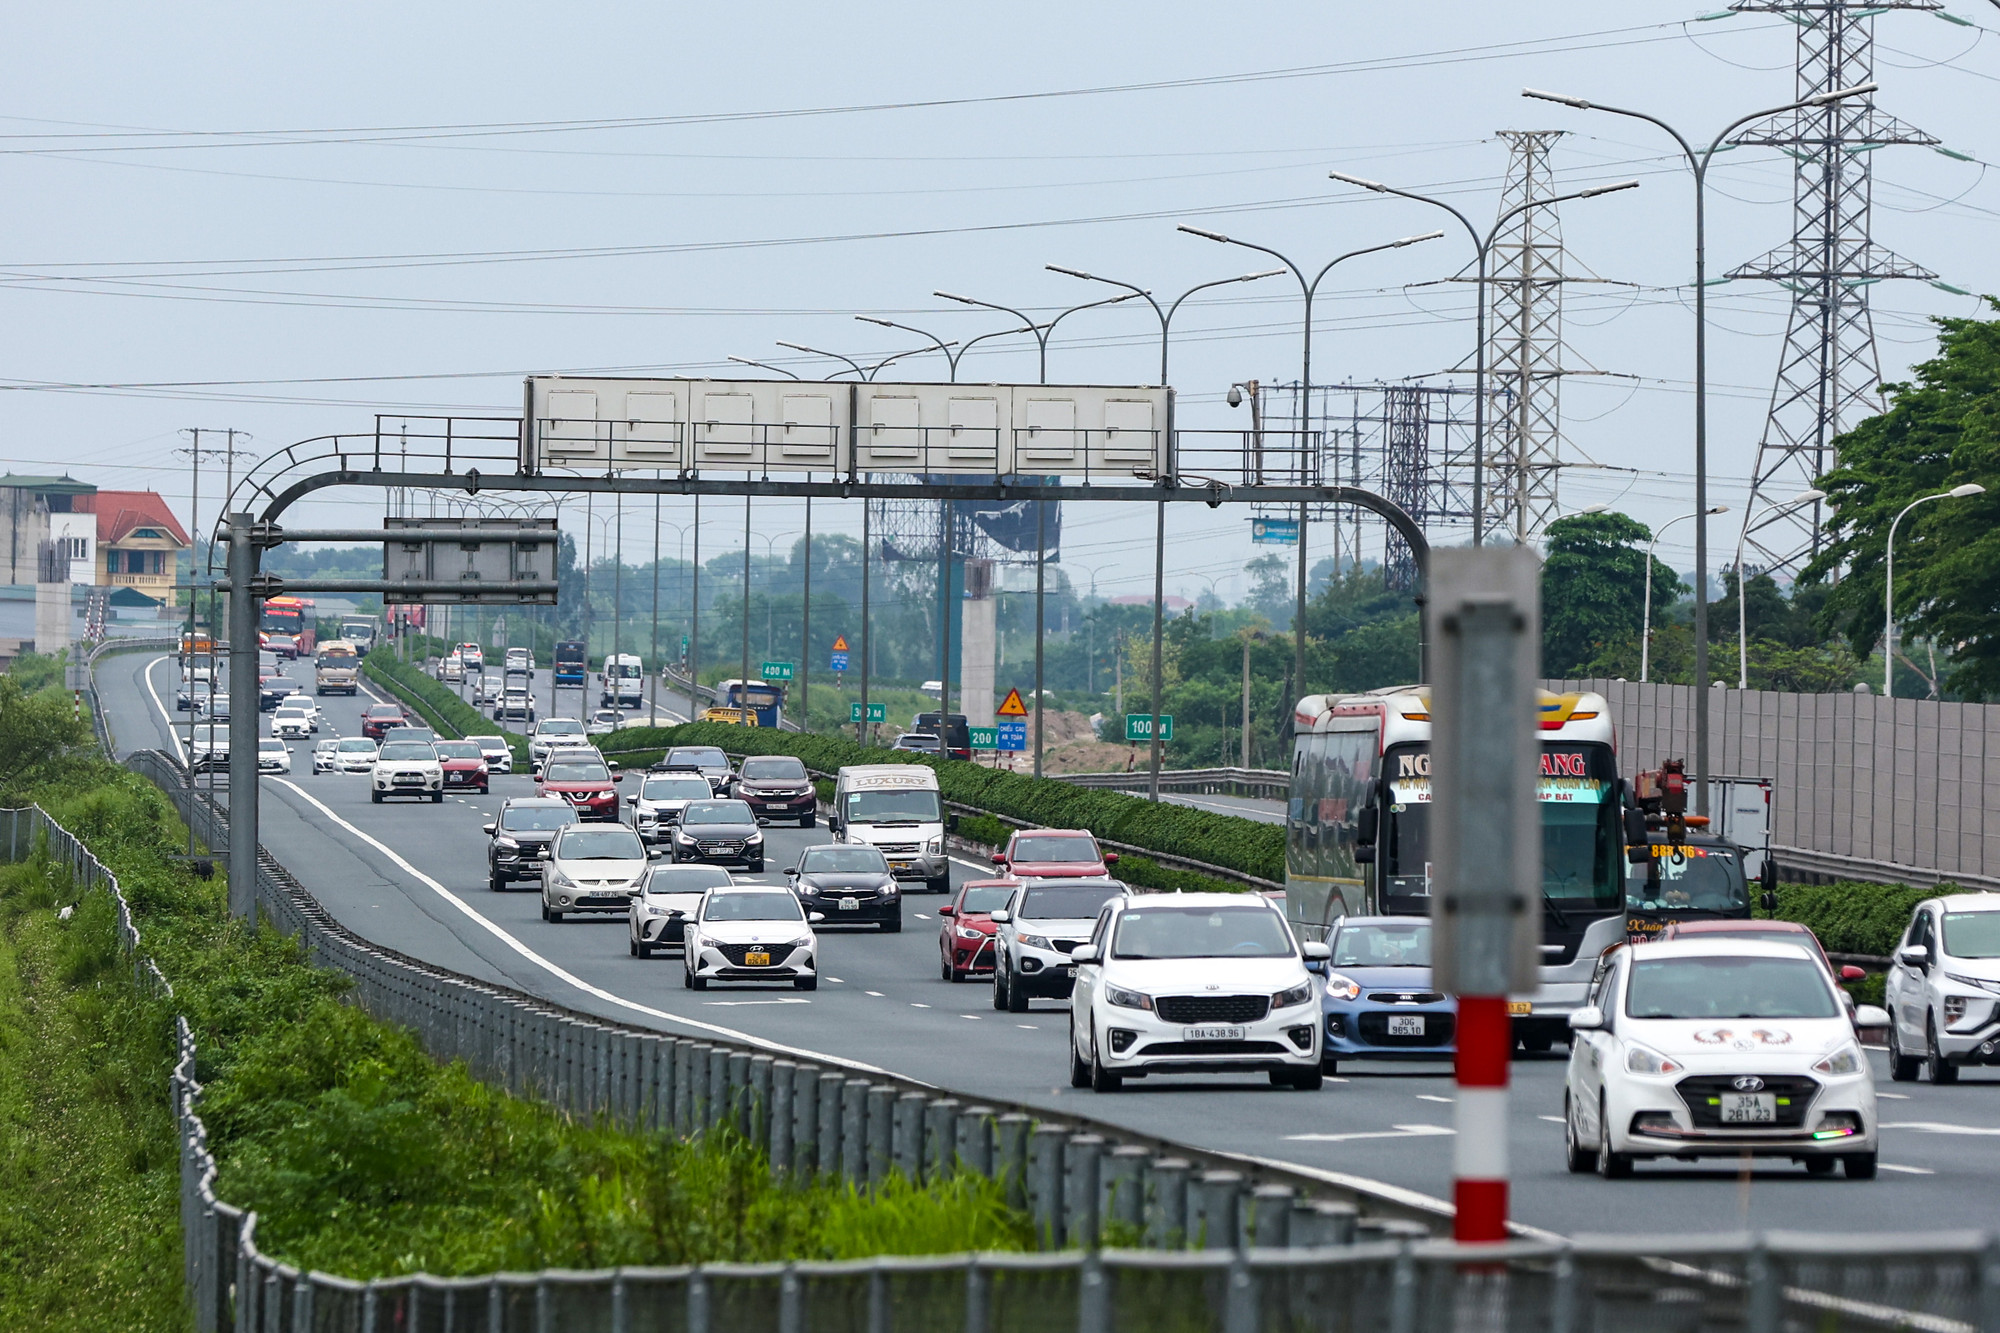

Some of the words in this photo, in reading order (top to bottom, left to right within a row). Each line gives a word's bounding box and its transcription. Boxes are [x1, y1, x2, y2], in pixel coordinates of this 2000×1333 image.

[764, 665, 780, 676] 400
[782, 667, 791, 676] M
[854, 707, 871, 718] 30
[873, 709, 882, 718] M
[1131, 720, 1152, 734] 100
[972, 732, 992, 744] 200
[856, 777, 927, 786] LUXURY
[1399, 776, 1411, 790] HÀ
[1555, 791, 1573, 801] BÁT
[1651, 844, 1696, 859] 88816
[1399, 1018, 1415, 1026] 30G
[1392, 1026, 1421, 1035] 985.10
[1737, 1096, 1760, 1108] 35A
[1728, 1108, 1770, 1121] 281.23
